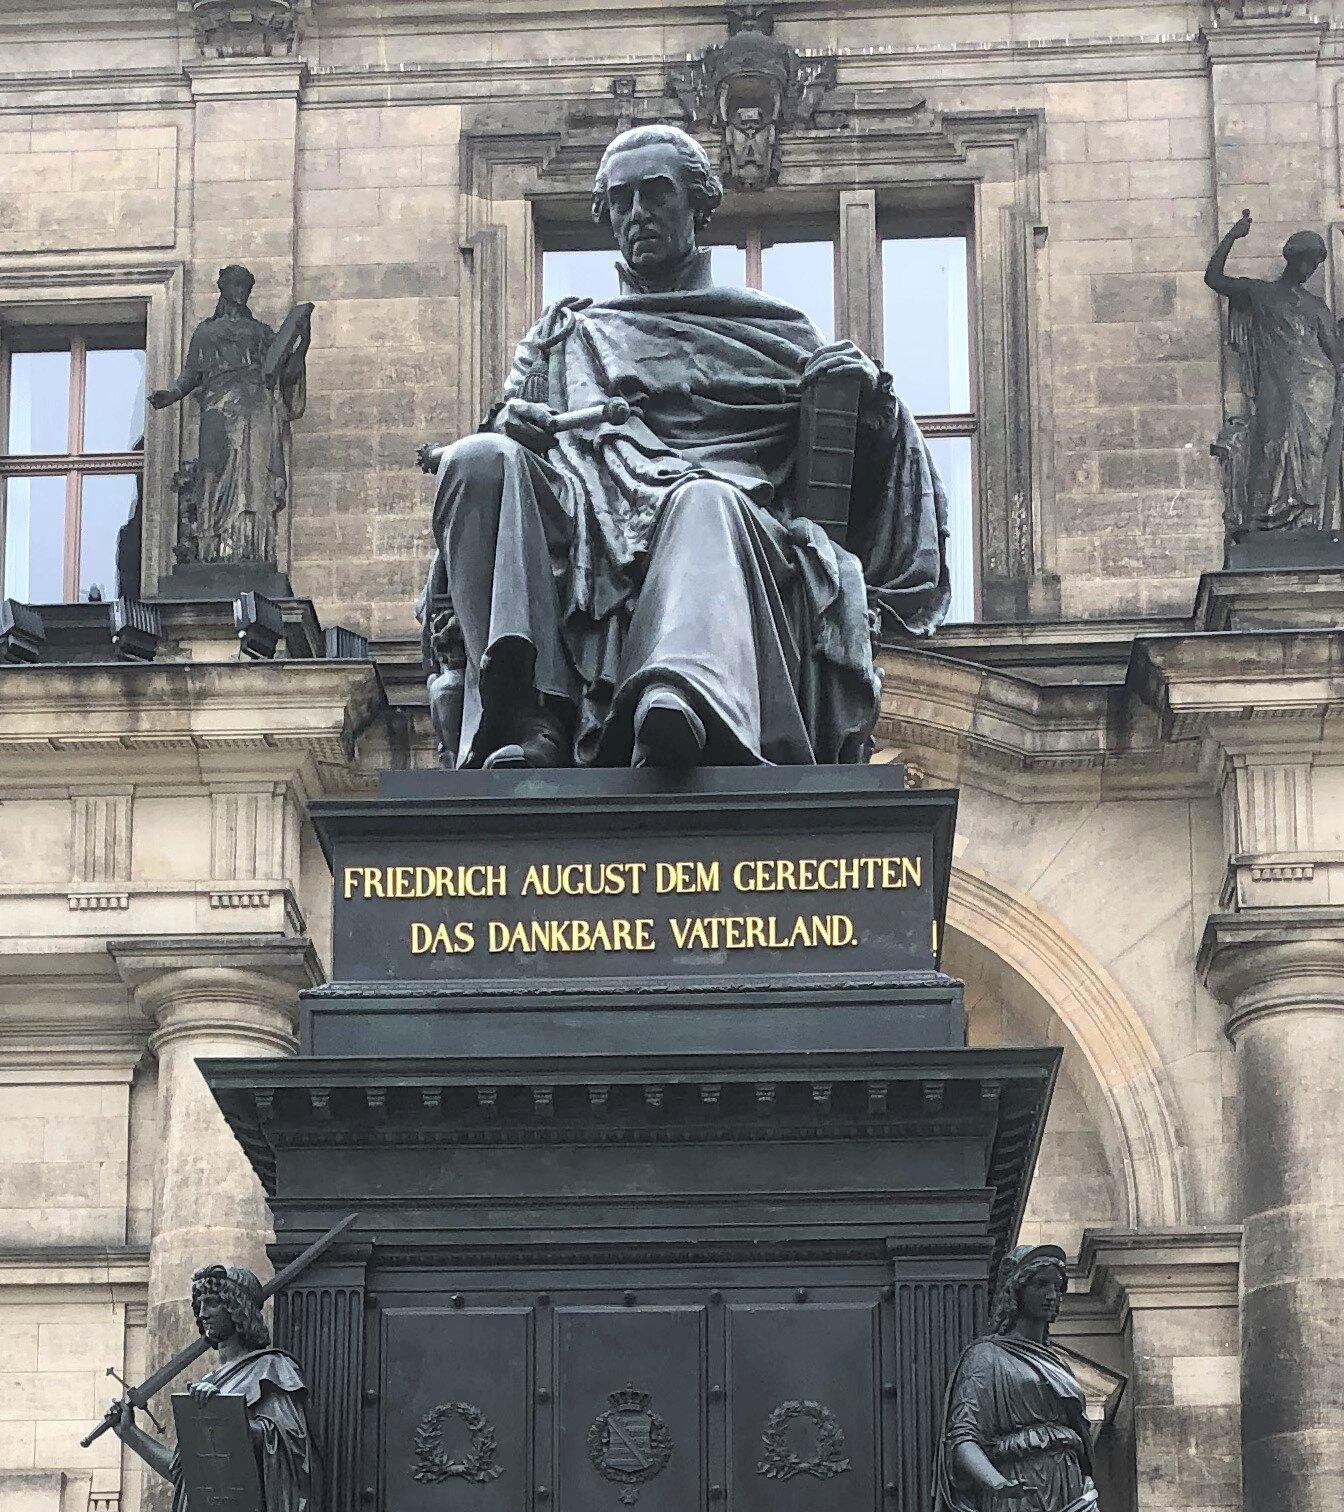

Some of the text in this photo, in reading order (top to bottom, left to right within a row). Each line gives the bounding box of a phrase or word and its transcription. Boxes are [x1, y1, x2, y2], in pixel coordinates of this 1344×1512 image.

[343, 857, 922, 898] FRIEDRICH AUGUST DEM GERECHTEN
[410, 914, 859, 953] DAS DANKBARE VATERLAND.
